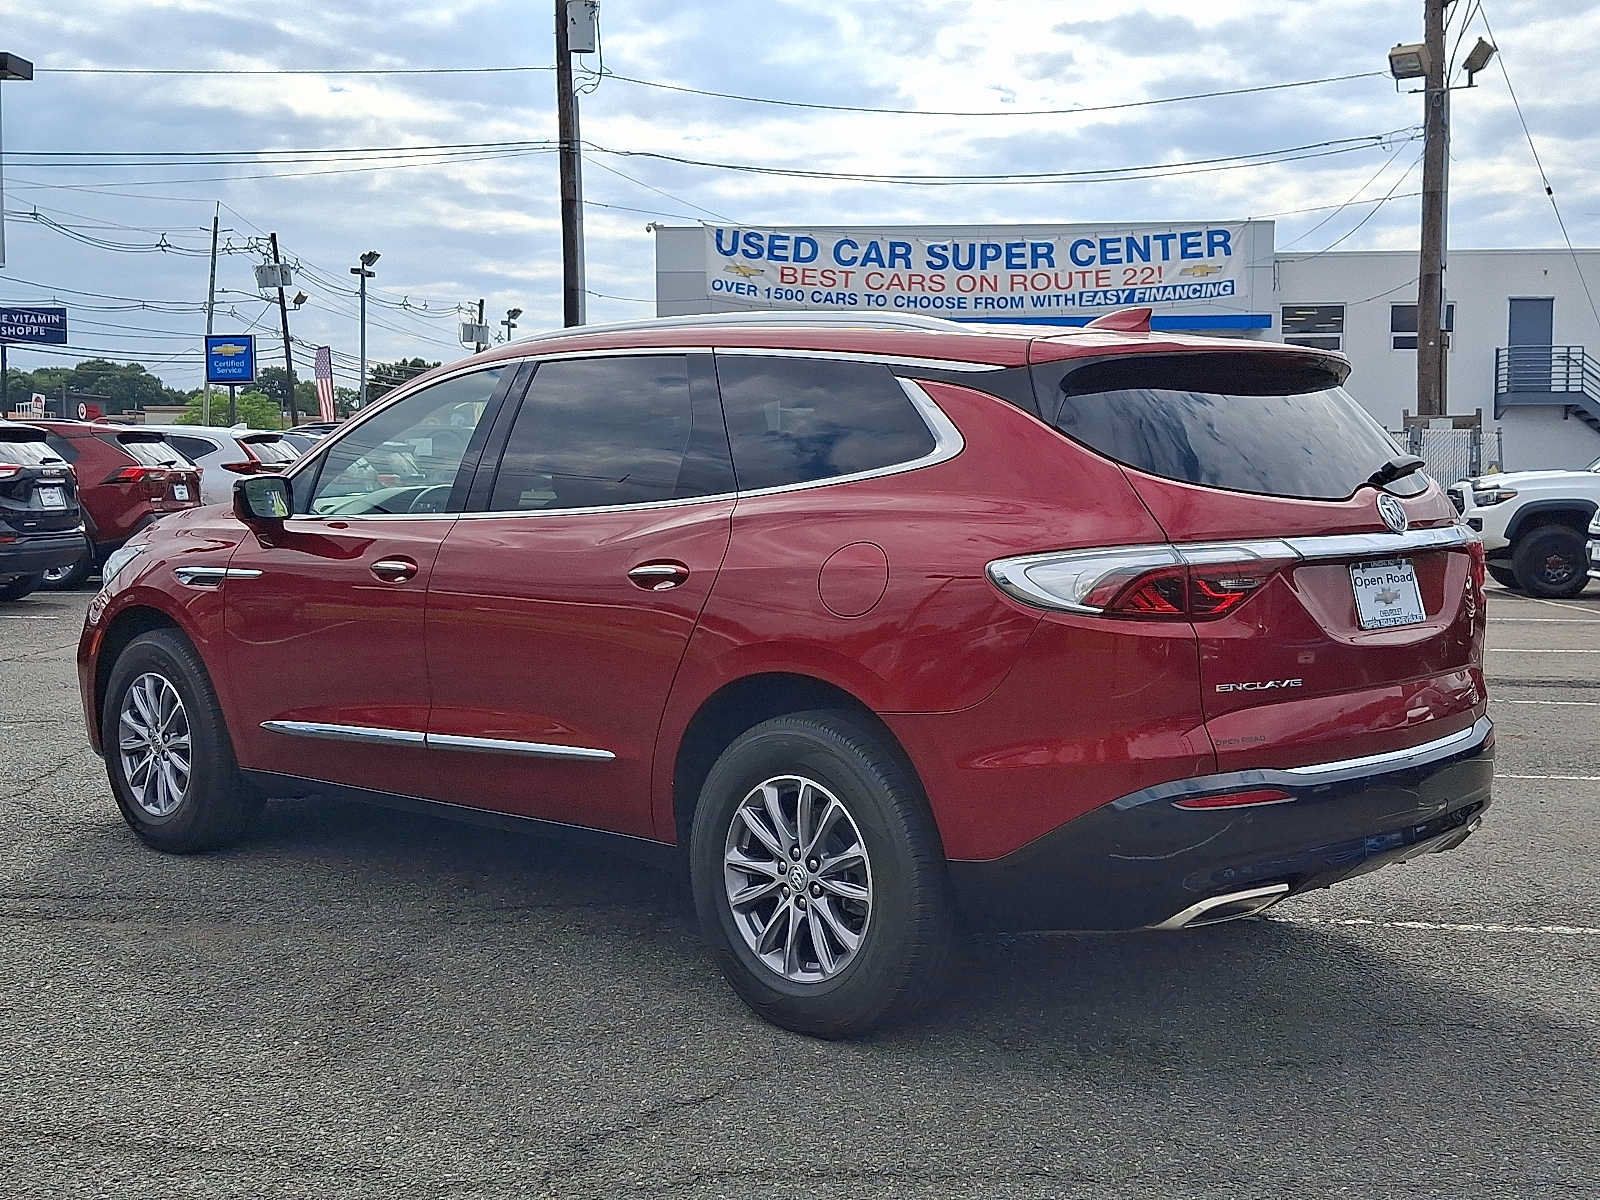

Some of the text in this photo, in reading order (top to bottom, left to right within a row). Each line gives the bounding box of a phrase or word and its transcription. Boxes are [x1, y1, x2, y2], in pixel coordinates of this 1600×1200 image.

[715, 228, 1232, 271] USED CAR SUPER CENTER
[779, 266, 1163, 293] BEST CARS ON ROUTE 22!
[711, 279, 1233, 310] OVER 1500 CARS TO CHOOSE FROM WITH EASY FINANCING
[11, 314, 60, 324] VITAMIN
[1, 326, 46, 336] SHOPPE
[1354, 571, 1413, 589] Open Road
[1215, 678, 1303, 693] ENCLAVE
